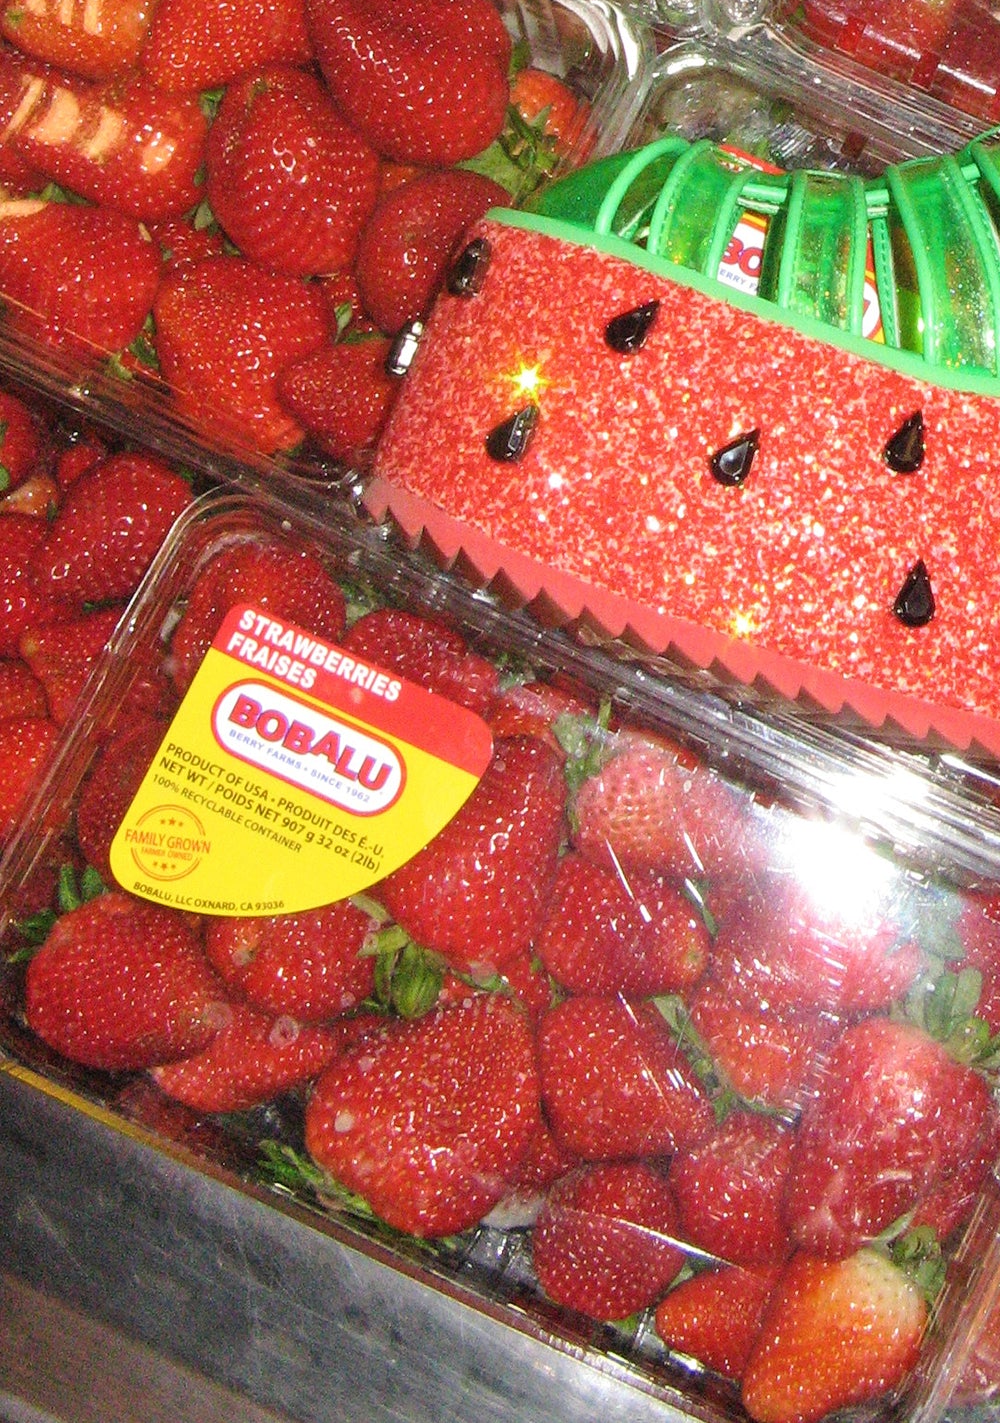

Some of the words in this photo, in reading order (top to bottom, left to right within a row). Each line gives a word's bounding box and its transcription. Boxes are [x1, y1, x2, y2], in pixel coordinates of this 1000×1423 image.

[720, 268, 746, 284] ERRY
[227, 631, 317, 688] FRAISES
[239, 609, 401, 701] STRAWBERRIES
[227, 693, 392, 791] BOBALU
[228, 728, 264, 750] BERRY
[266, 747, 301, 769] FARMS
[310, 768, 342, 789] SINCE
[346, 786, 370, 802] 1962
[153, 773, 179, 793] 100%
[180, 787, 243, 824] RECYCLABLE
[244, 818, 302, 853] CONTAINER
[159, 756, 186, 775] NET
[186, 768, 208, 786] WT
[214, 783, 254, 810] POIDS
[254, 803, 281, 822] NET
[281, 816, 306, 834] 907
[305, 831, 315, 843] g
[316, 833, 333, 849] 32
[334, 845, 349, 857] oz
[350, 850, 380, 873] (2lb)
[165, 742, 225, 778] PRODUCT
[225, 772, 243, 786] OF
[243, 780, 268, 801] USA
[276, 797, 332, 830] PRODUIT
[332, 824, 357, 843] DES
[124, 828, 165, 846] FAMILY
[166, 836, 211, 854] GROWN
[132, 881, 173, 902] BOBALU,
[174, 894, 192, 906] LLC
[193, 898, 237, 911] OXNARD,
[239, 903, 253, 911] CA
[254, 900, 284, 911] 93036
